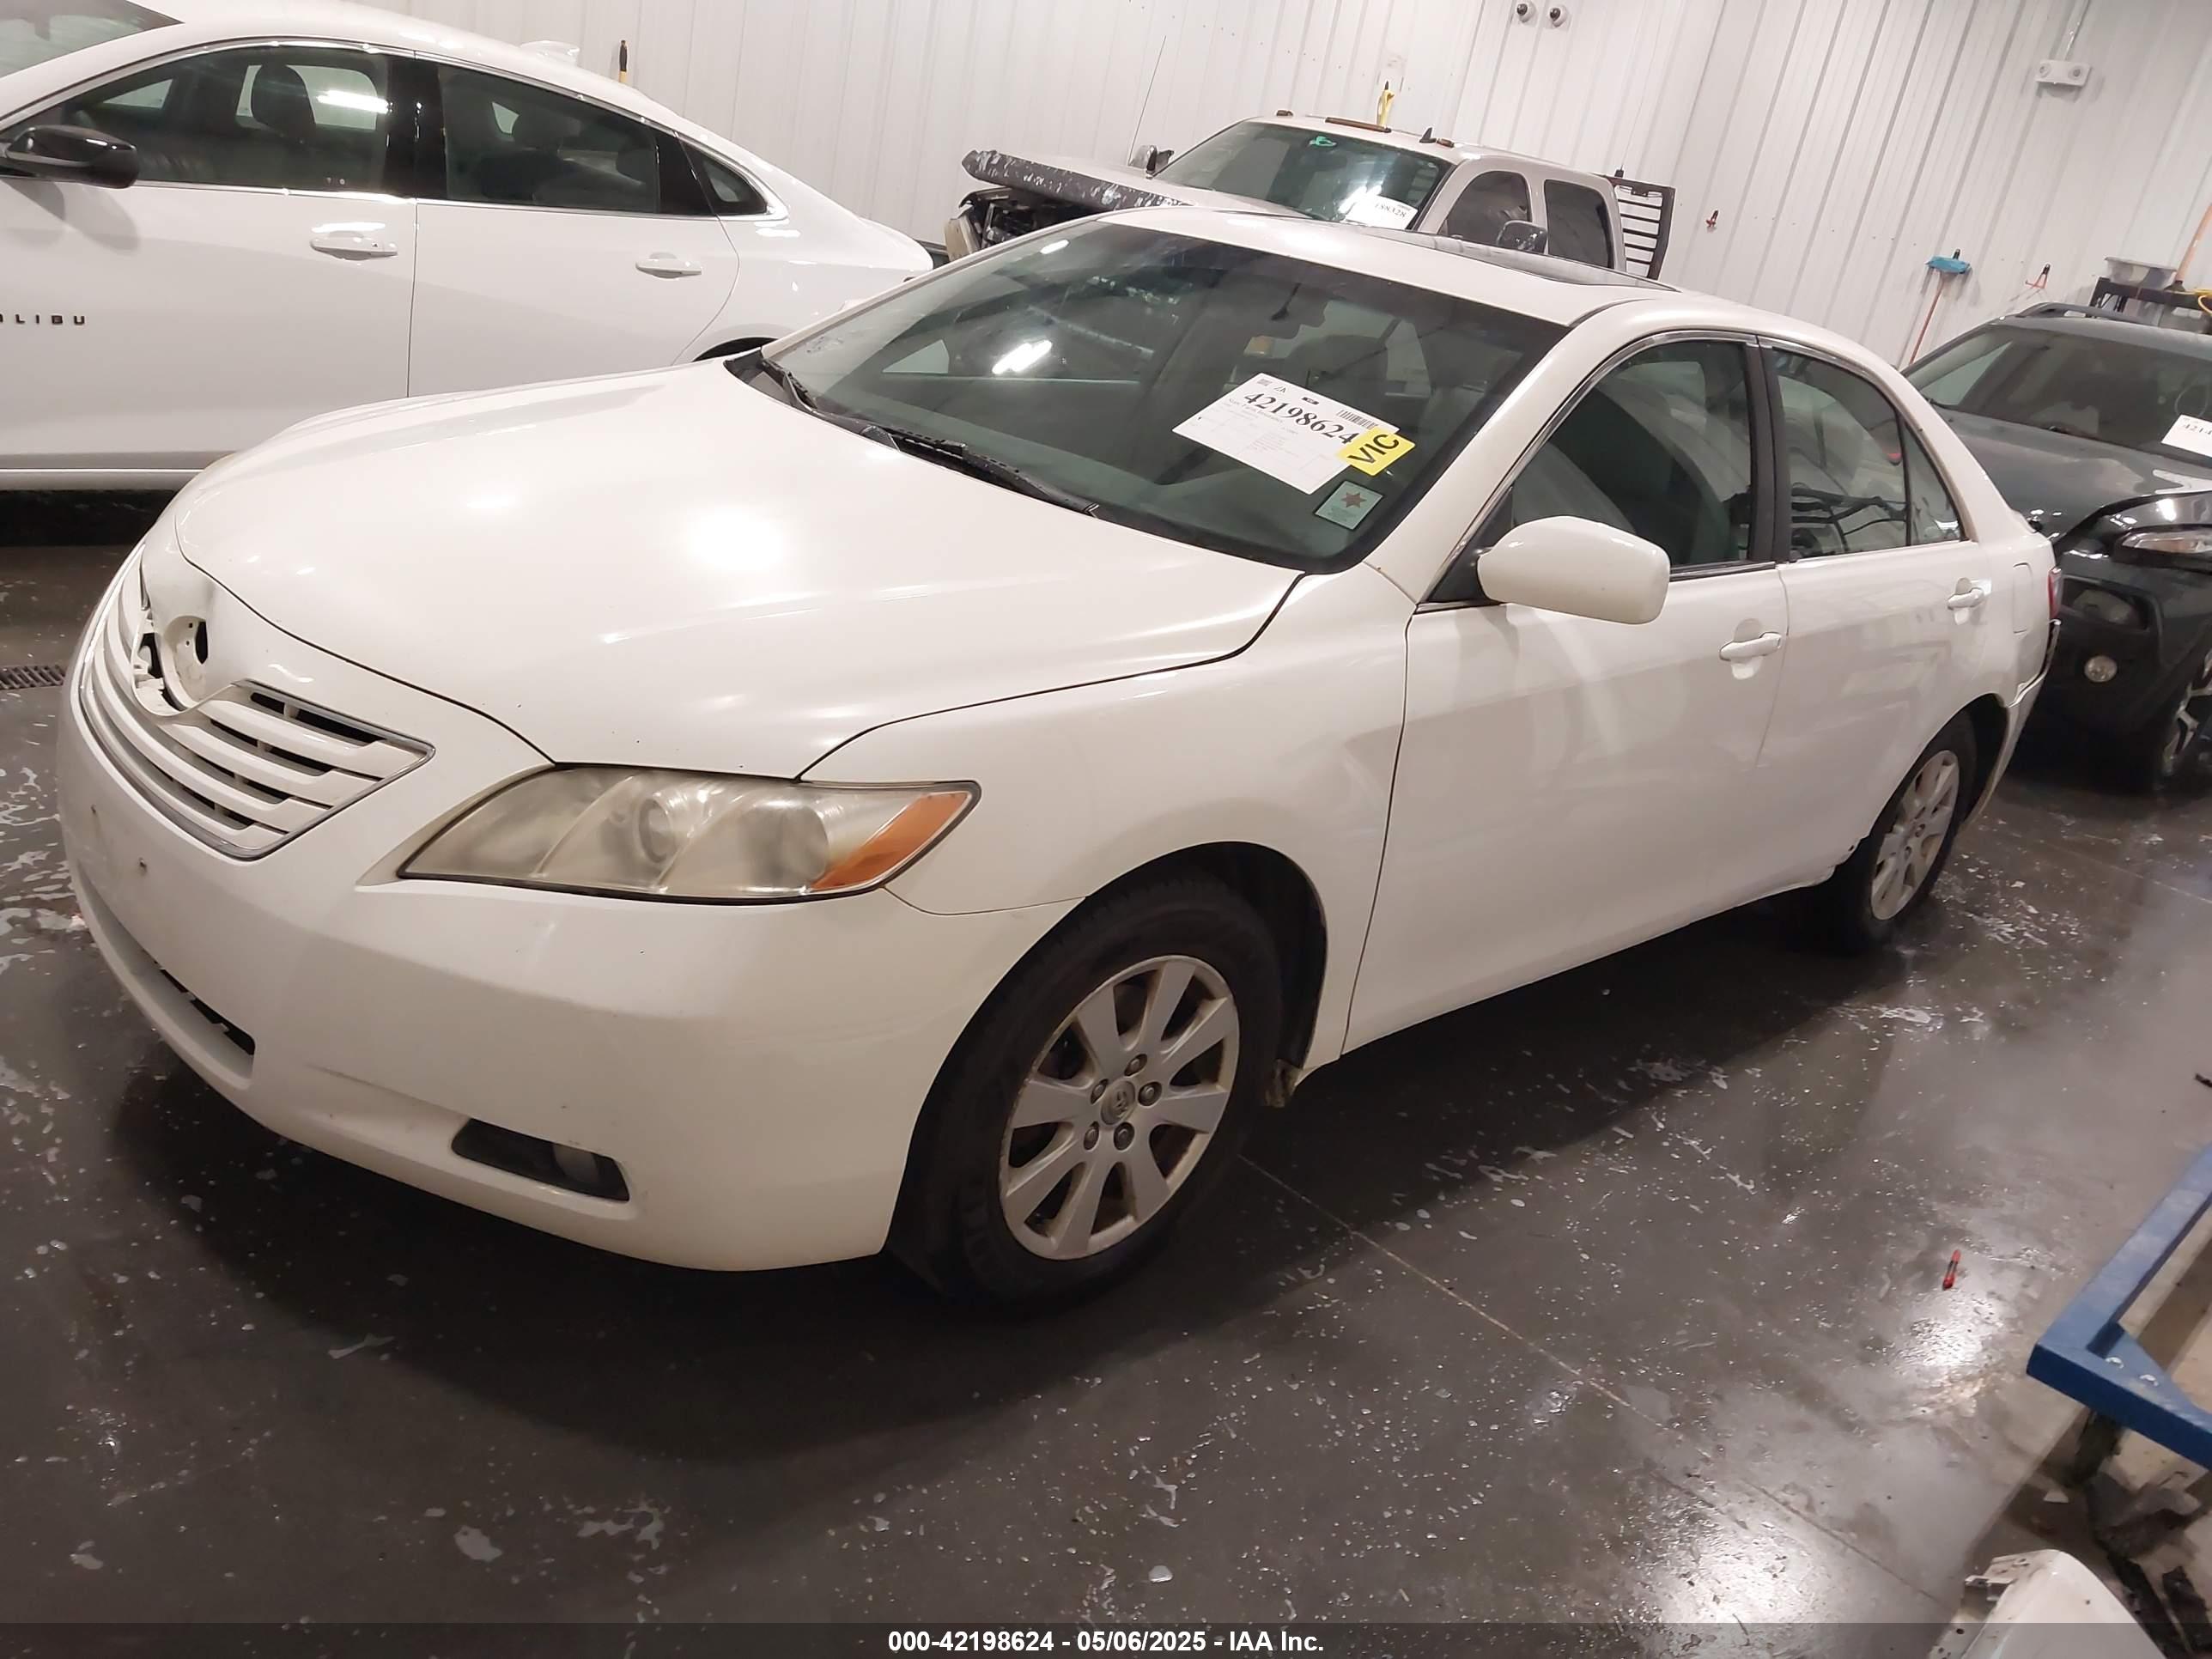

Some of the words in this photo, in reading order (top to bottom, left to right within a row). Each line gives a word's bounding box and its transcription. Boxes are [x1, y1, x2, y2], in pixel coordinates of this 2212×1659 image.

[0, 313, 85, 325] LIBU
[1244, 393, 1360, 445] 42198624
[1346, 434, 1400, 464] VIC
